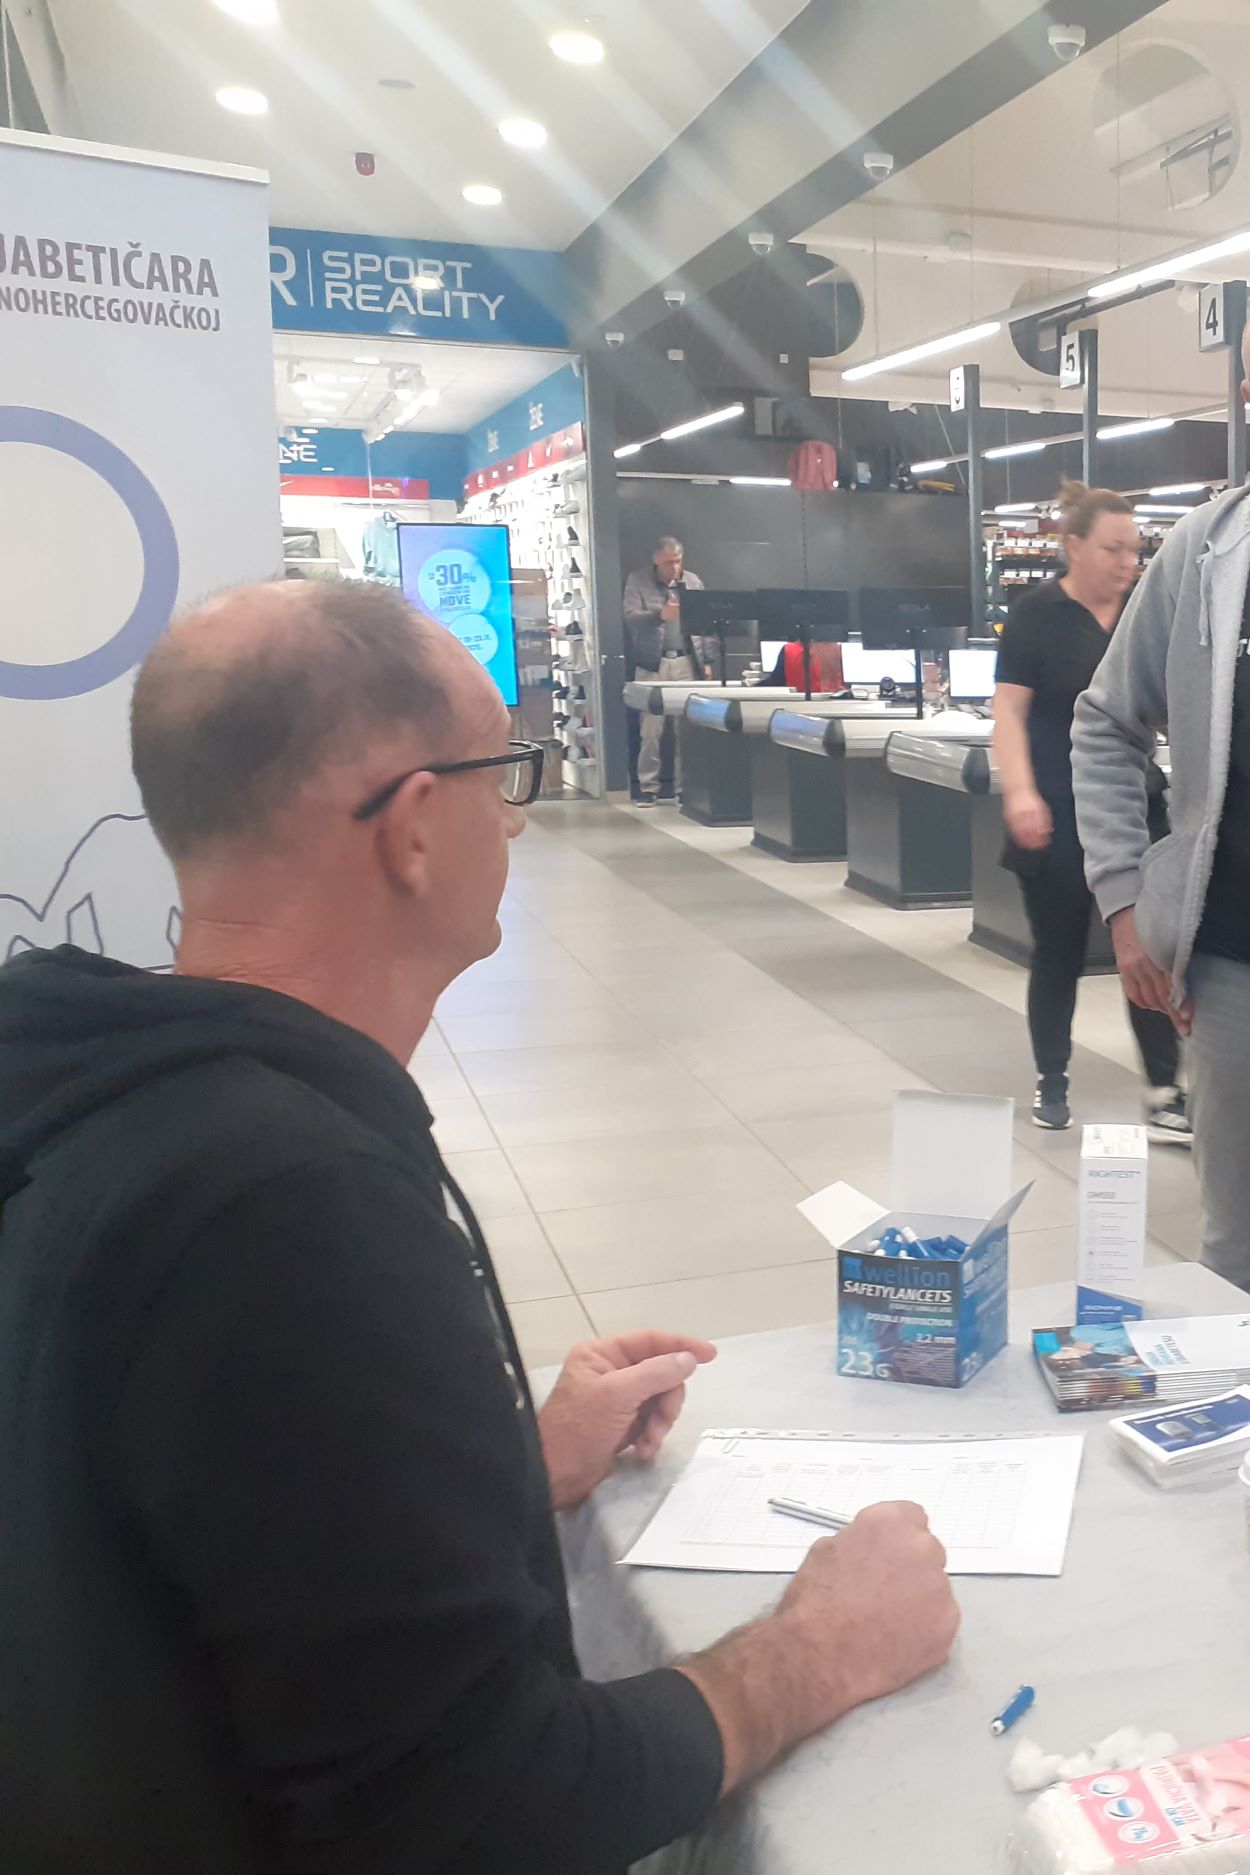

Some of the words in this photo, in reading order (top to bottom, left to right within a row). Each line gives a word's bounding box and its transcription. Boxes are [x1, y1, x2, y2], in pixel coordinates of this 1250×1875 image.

[322, 249, 472, 289] SPORT
[324, 280, 505, 321] REALITY
[1205, 297, 1219, 337] 4
[1066, 343, 1077, 373] 5
[843, 1280, 952, 1303] SAFETYLANCETS
[864, 1263, 950, 1288] wellion
